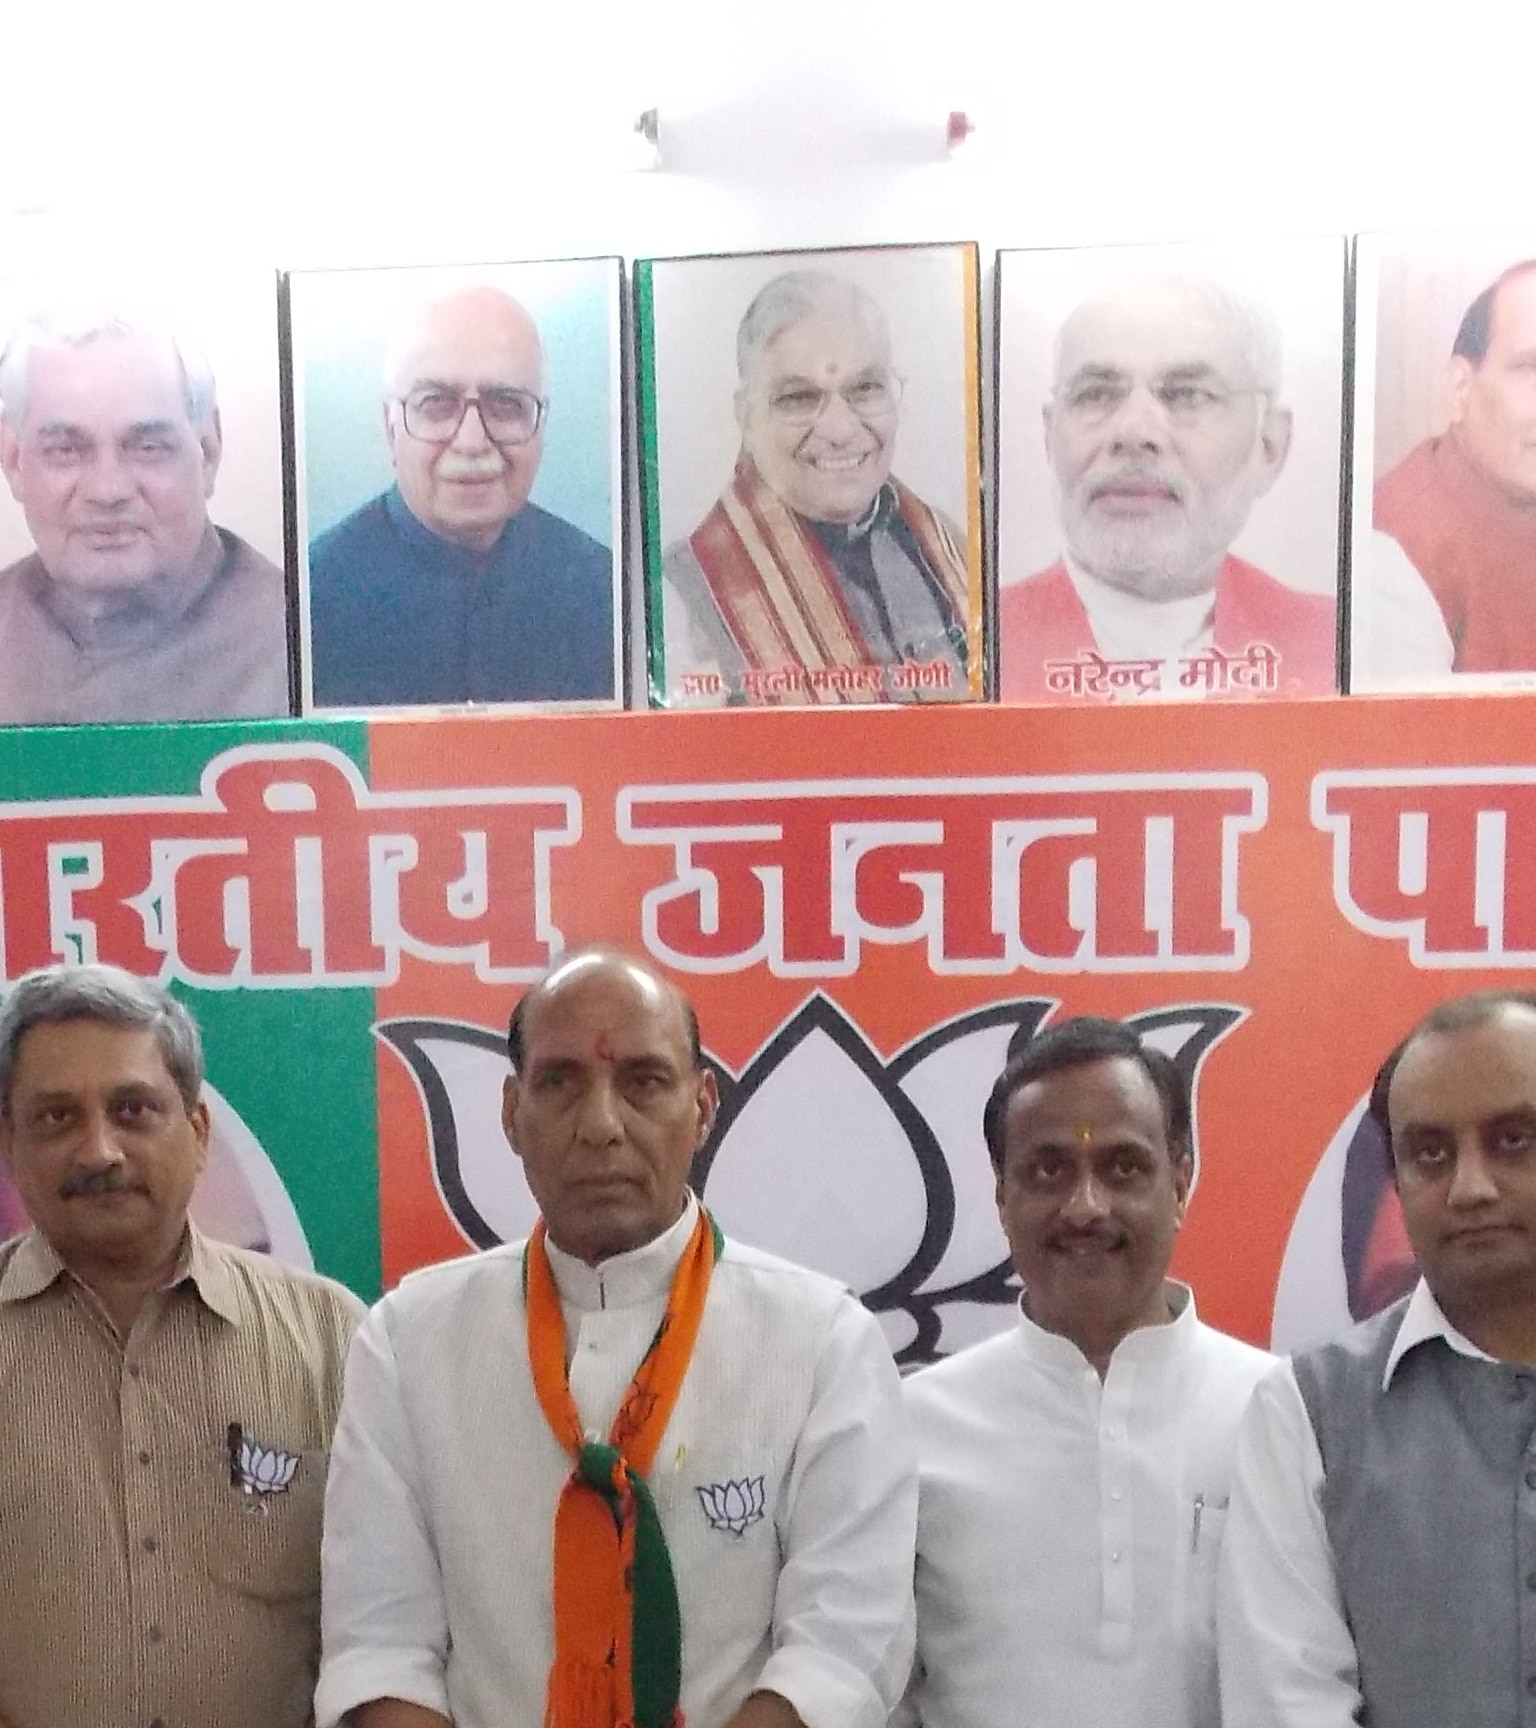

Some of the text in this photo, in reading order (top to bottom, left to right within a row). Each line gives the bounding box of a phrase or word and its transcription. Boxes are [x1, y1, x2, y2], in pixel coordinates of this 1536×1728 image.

[1046, 643, 1280, 697] नरेन्द्र मोदी
[619, 773, 1265, 976] जनता
